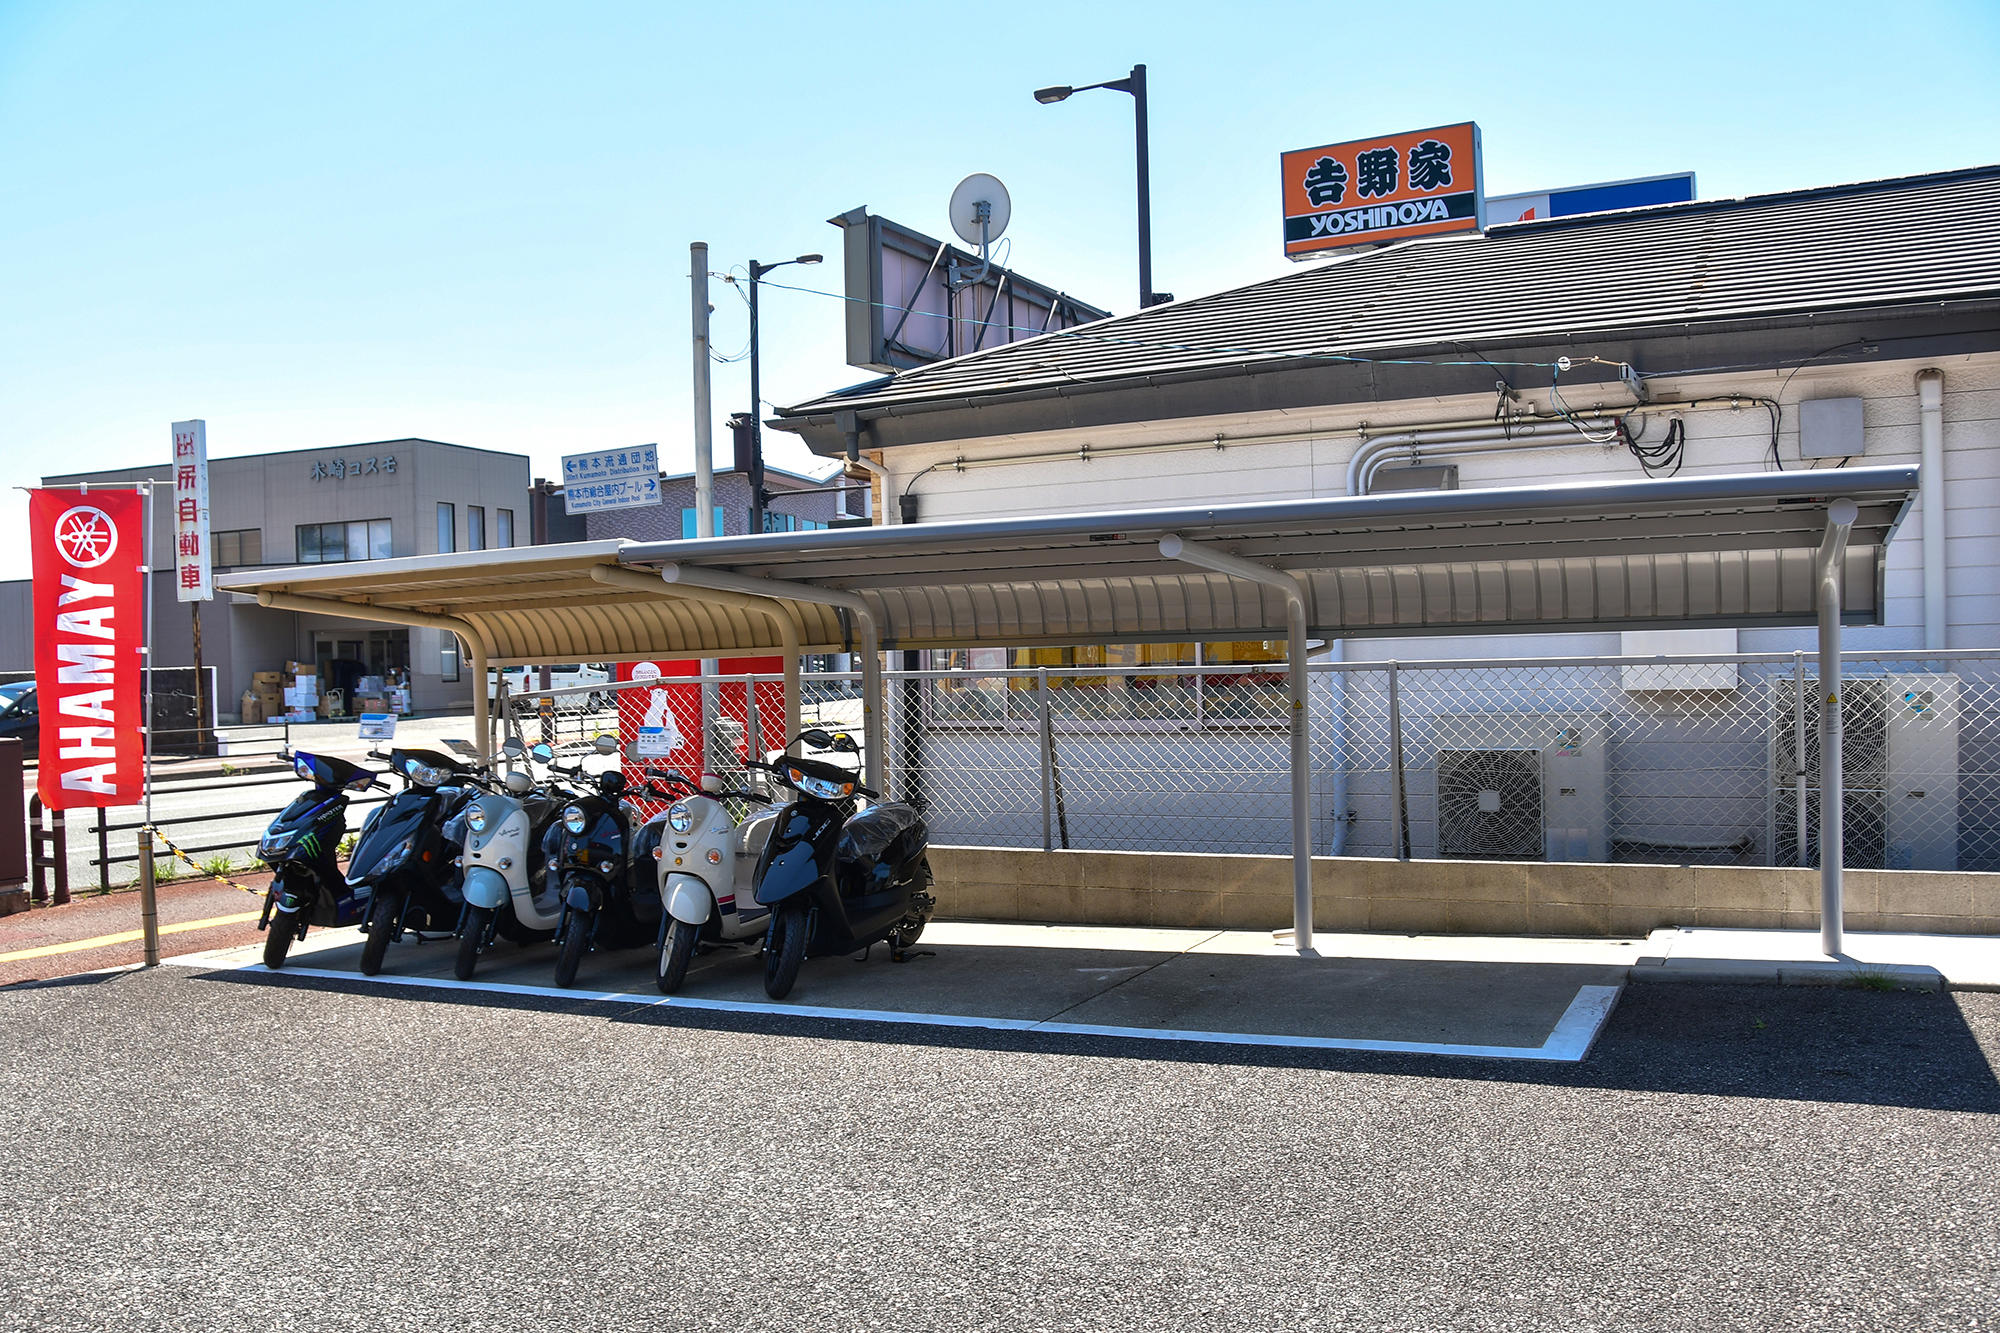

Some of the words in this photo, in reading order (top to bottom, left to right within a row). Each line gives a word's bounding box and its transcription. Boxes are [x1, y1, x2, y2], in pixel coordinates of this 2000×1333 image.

[1310, 199, 1450, 237] YOSHINOYA
[311, 456, 397, 481] 木崎コスモ
[579, 449, 655, 471] 熊本流通団地
